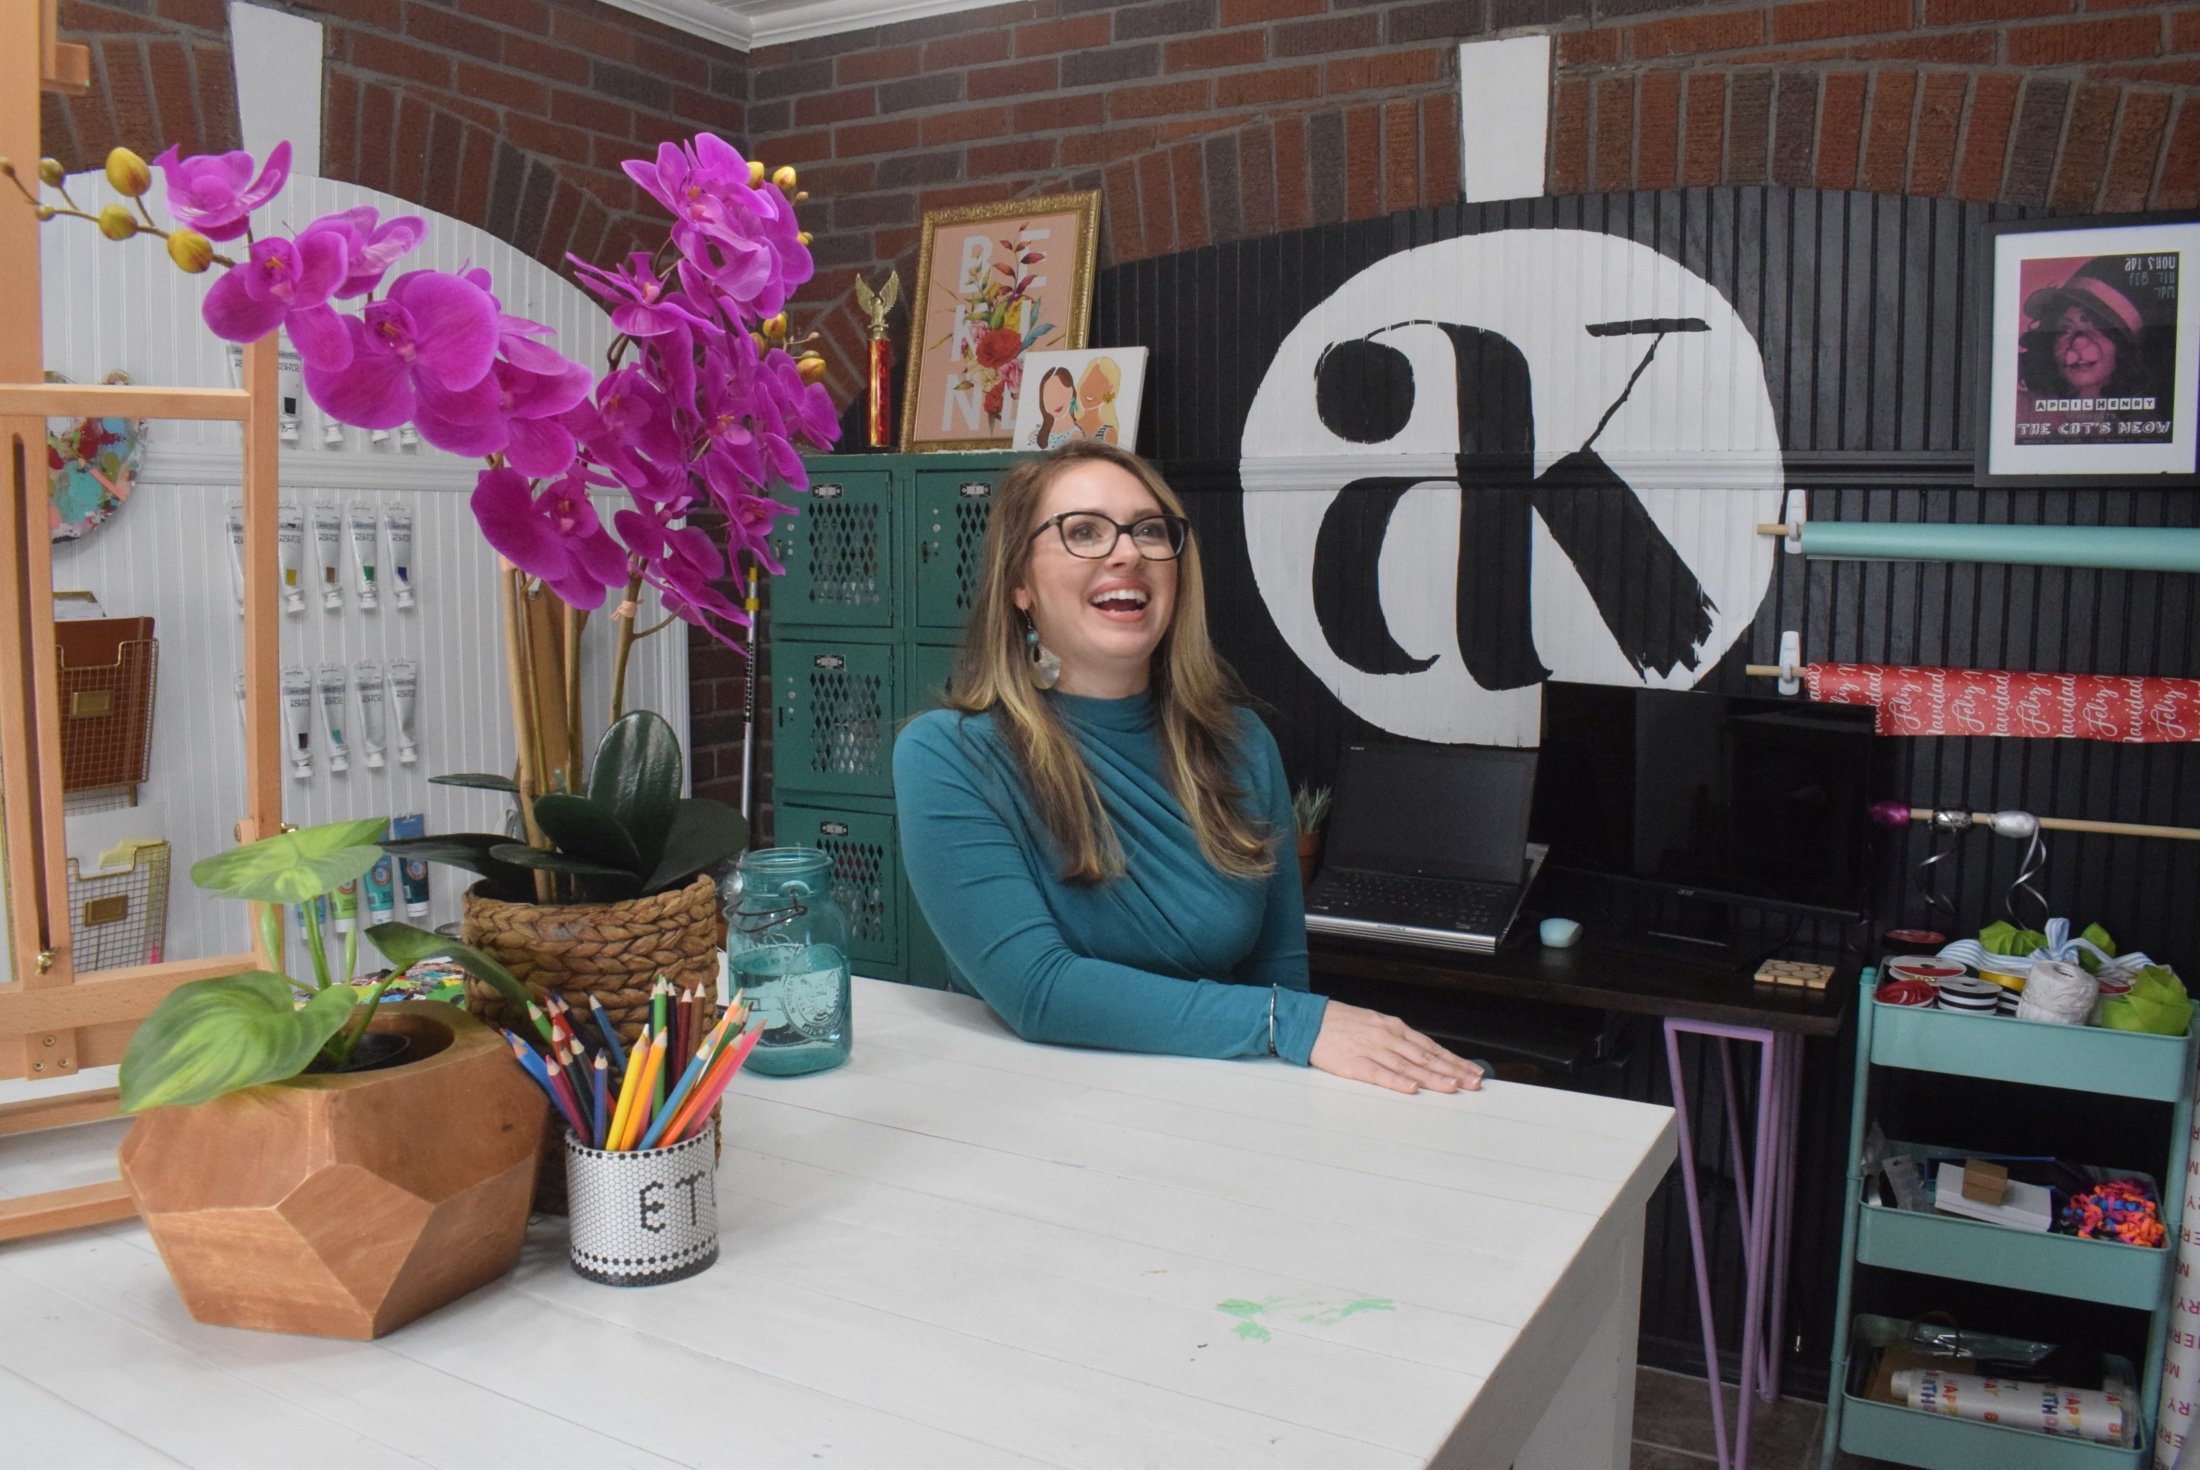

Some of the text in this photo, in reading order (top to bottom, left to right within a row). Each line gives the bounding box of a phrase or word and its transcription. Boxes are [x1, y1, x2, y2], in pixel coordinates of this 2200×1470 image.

[2036, 399, 2155, 411] APRIL HENRY
[2017, 421, 2171, 435] THE CAT'S MEOW
